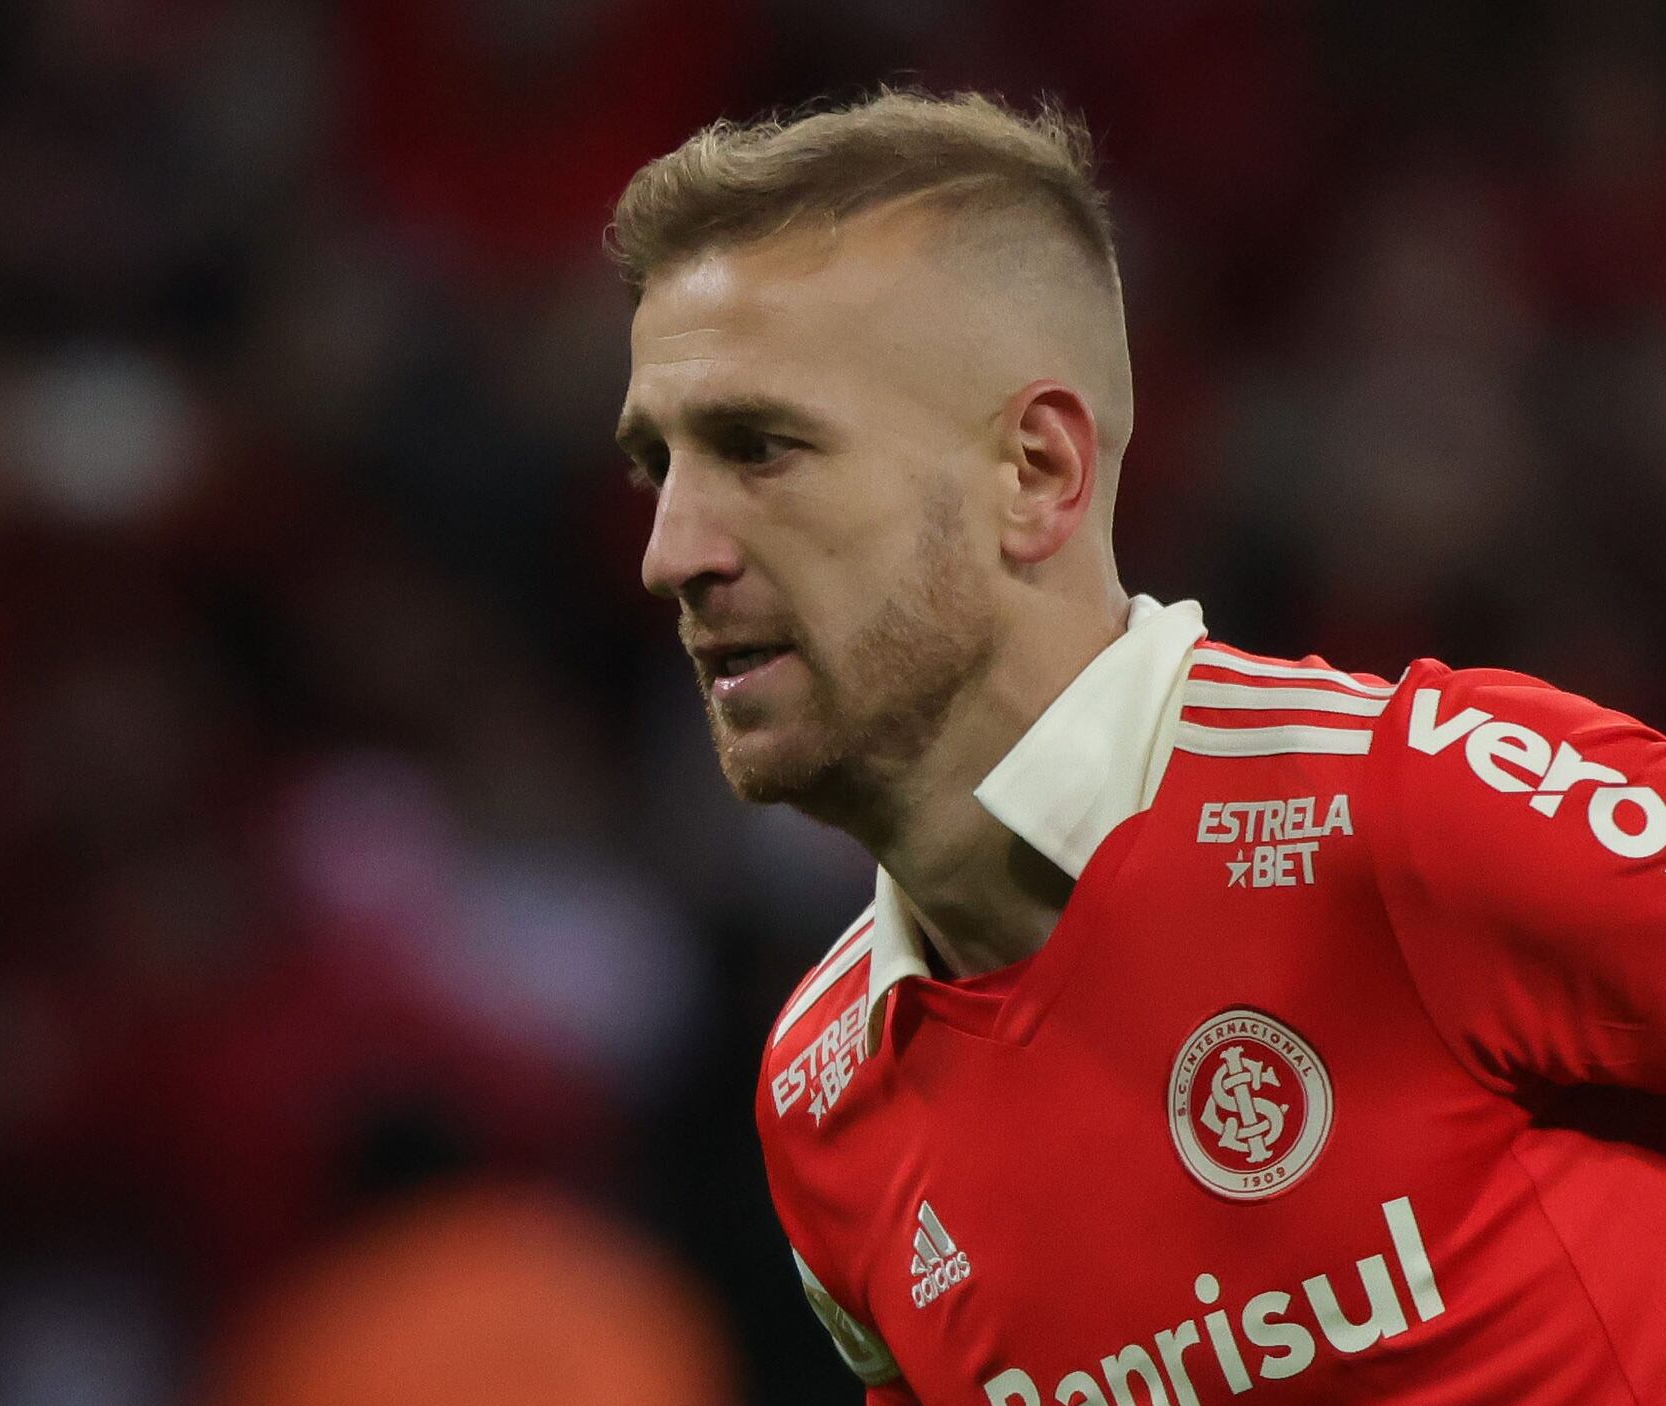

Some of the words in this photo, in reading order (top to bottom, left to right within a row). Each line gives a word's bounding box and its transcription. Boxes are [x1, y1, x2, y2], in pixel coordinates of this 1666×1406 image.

[1196, 794, 1354, 844] ESTRELA
[1252, 842, 1321, 888] BET
[771, 994, 868, 1118] ESTREL
[820, 1028, 868, 1109] BET
[1241, 1166, 1287, 1188] 1909
[911, 1251, 971, 1309] adidas
